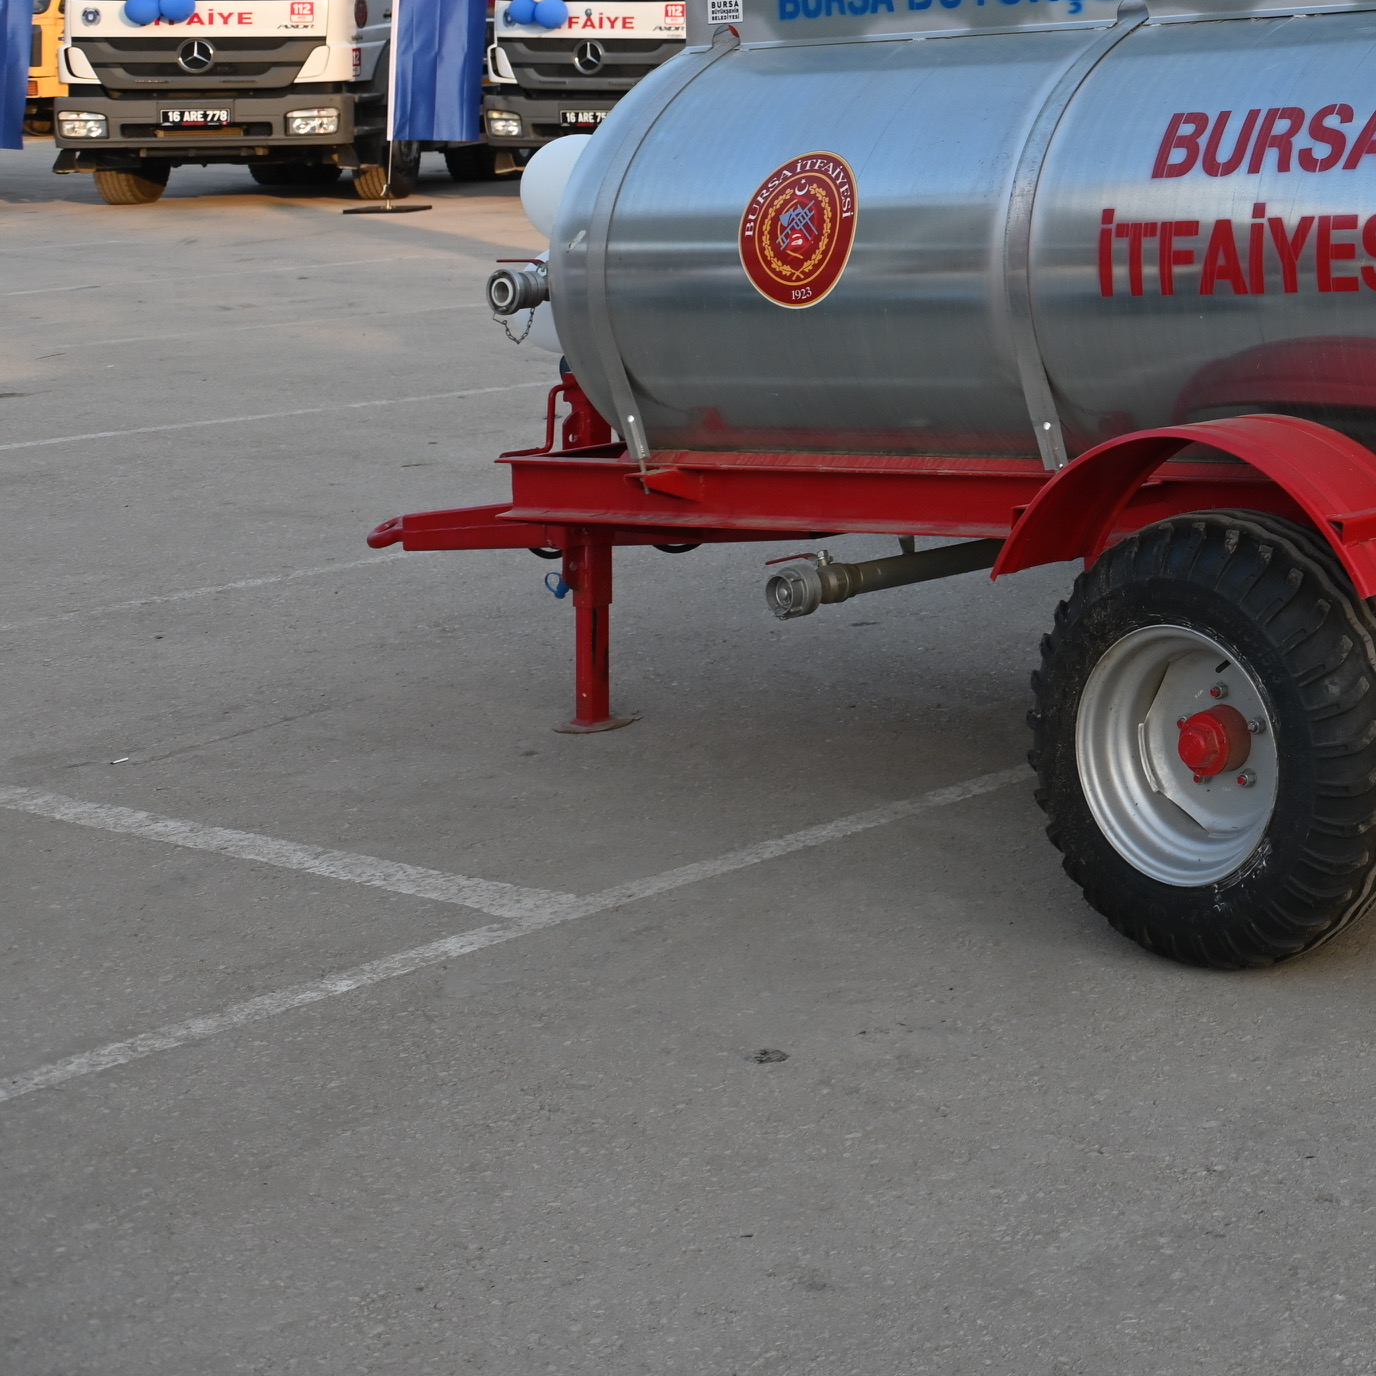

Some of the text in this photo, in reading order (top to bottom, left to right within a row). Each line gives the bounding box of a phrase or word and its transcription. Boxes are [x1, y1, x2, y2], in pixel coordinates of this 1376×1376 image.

[293, 3, 311, 15] 112
[666, 5, 683, 16] 112
[711, 0, 740, 9] BURSA
[168, 110, 228, 122] 16 ARE 778
[566, 112, 576, 123] 16
[577, 112, 594, 123] ARE
[744, 159, 854, 237] BURSA İTFAİYESİ
[791, 286, 813, 300] 1923
